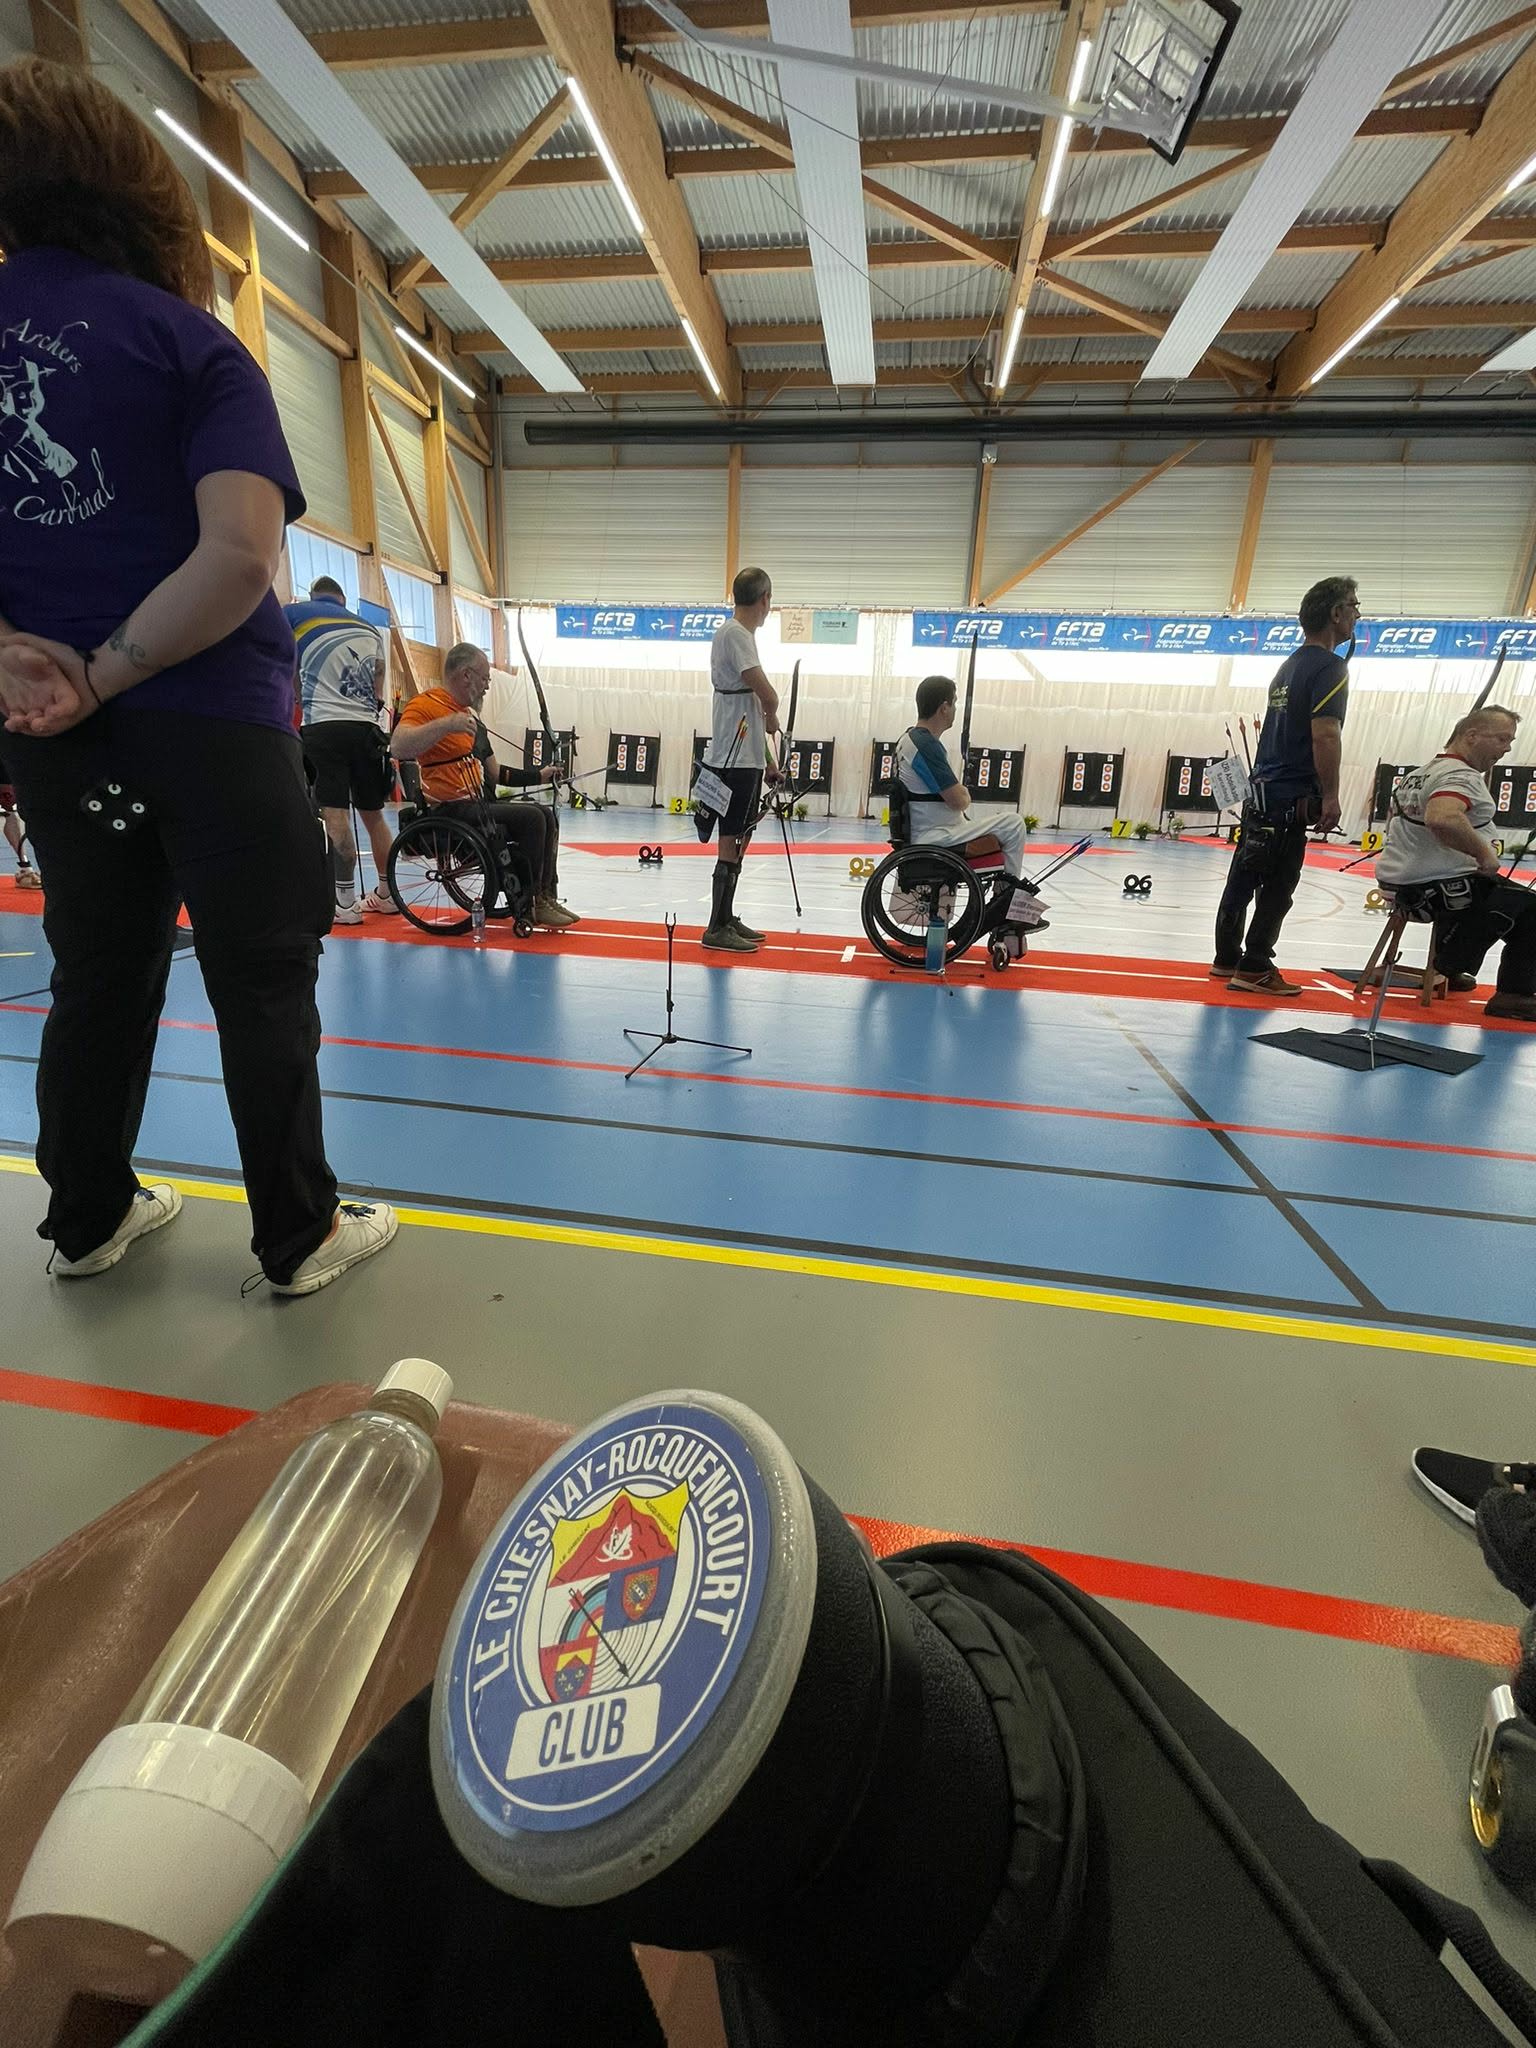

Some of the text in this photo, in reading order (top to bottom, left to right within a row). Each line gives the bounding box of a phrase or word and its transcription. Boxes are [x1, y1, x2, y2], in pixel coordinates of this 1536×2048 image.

[2, 319, 88, 373] Archers
[1266, 626, 1304, 641] FFT
[1496, 629, 1536, 645] FFT
[575, 794, 583, 808] 2
[675, 798, 683, 812] 3
[1119, 821, 1128, 836] 7
[1368, 834, 1378, 849] 9
[639, 846, 663, 861] 04
[849, 857, 875, 878] 05
[1124, 874, 1152, 891] 06
[473, 1432, 746, 1693] LE CHESNAY-ROCQUENCOURT
[538, 1697, 628, 1768] CLUB
